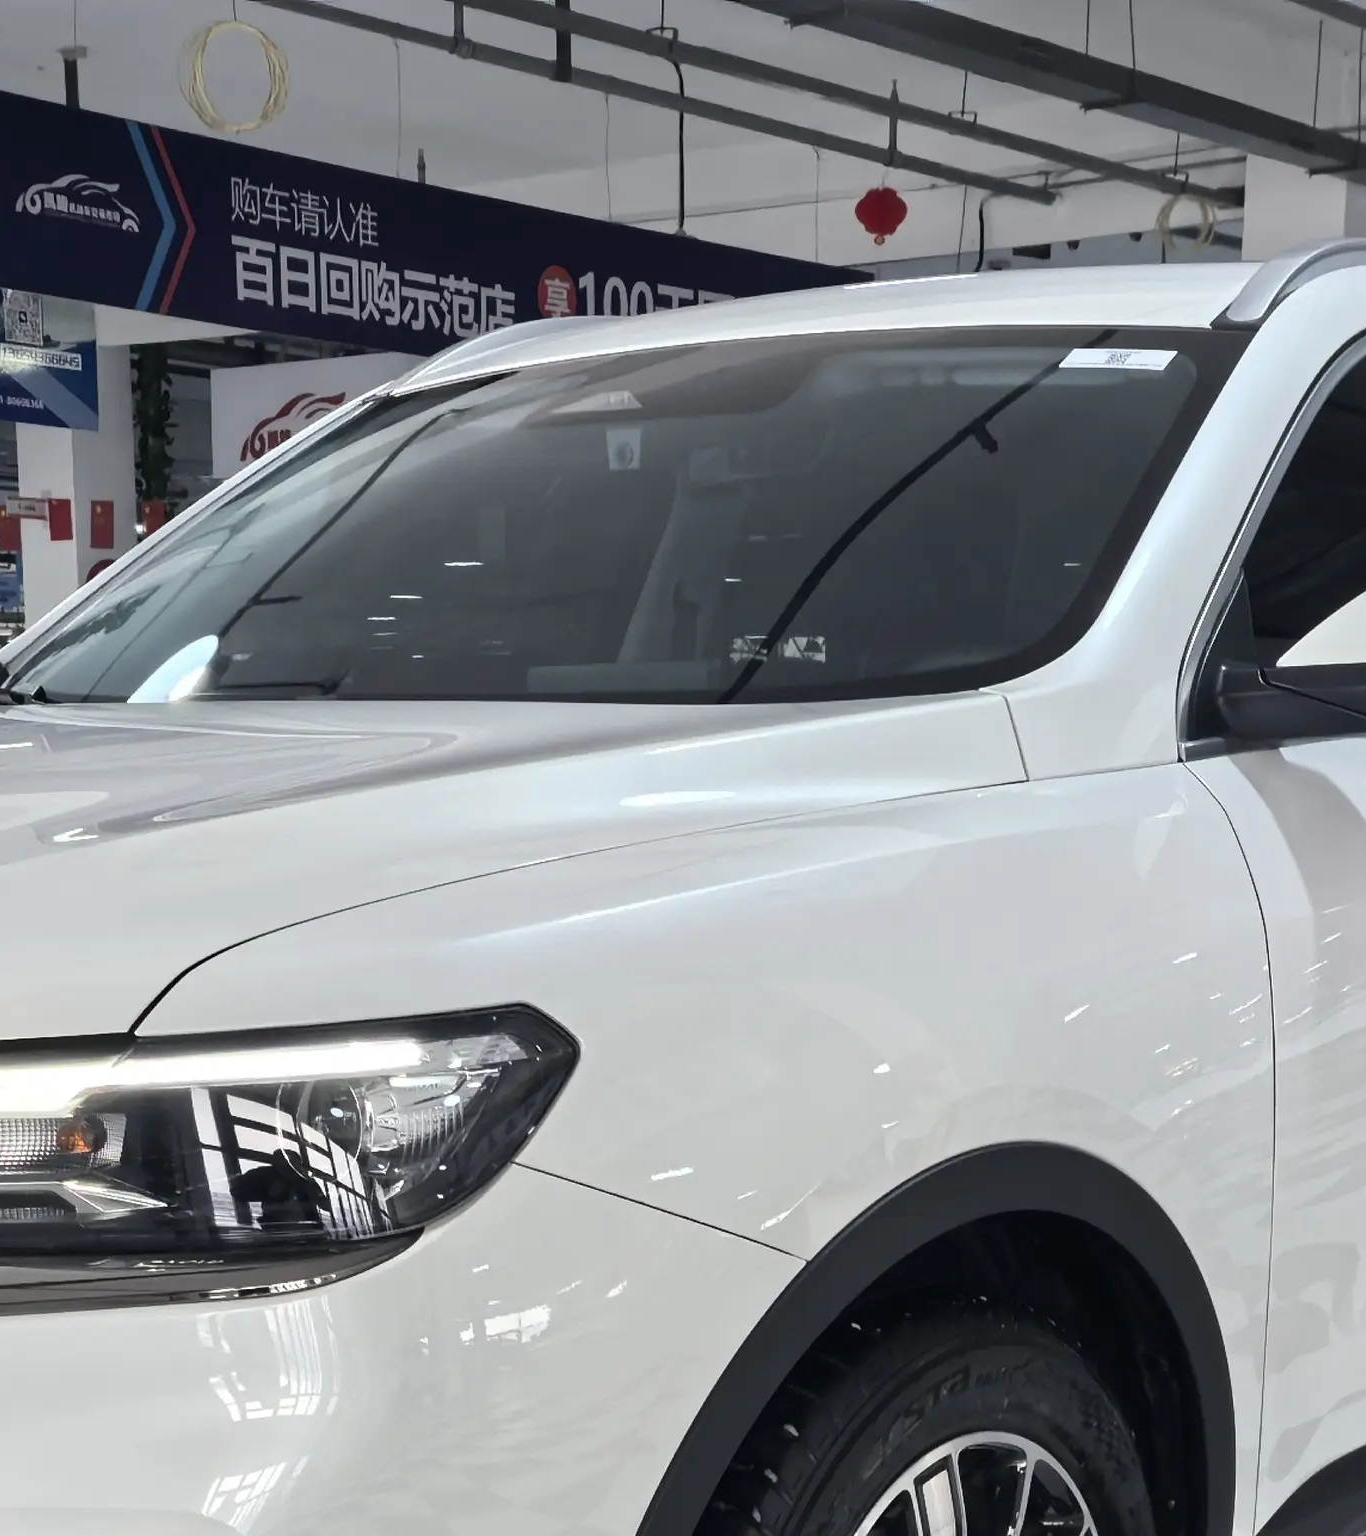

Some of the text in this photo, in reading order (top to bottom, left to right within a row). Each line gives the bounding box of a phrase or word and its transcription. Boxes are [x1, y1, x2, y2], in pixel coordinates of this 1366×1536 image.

[231, 176, 379, 247] 购车请认准
[231, 234, 516, 338] 百日回购示范店
